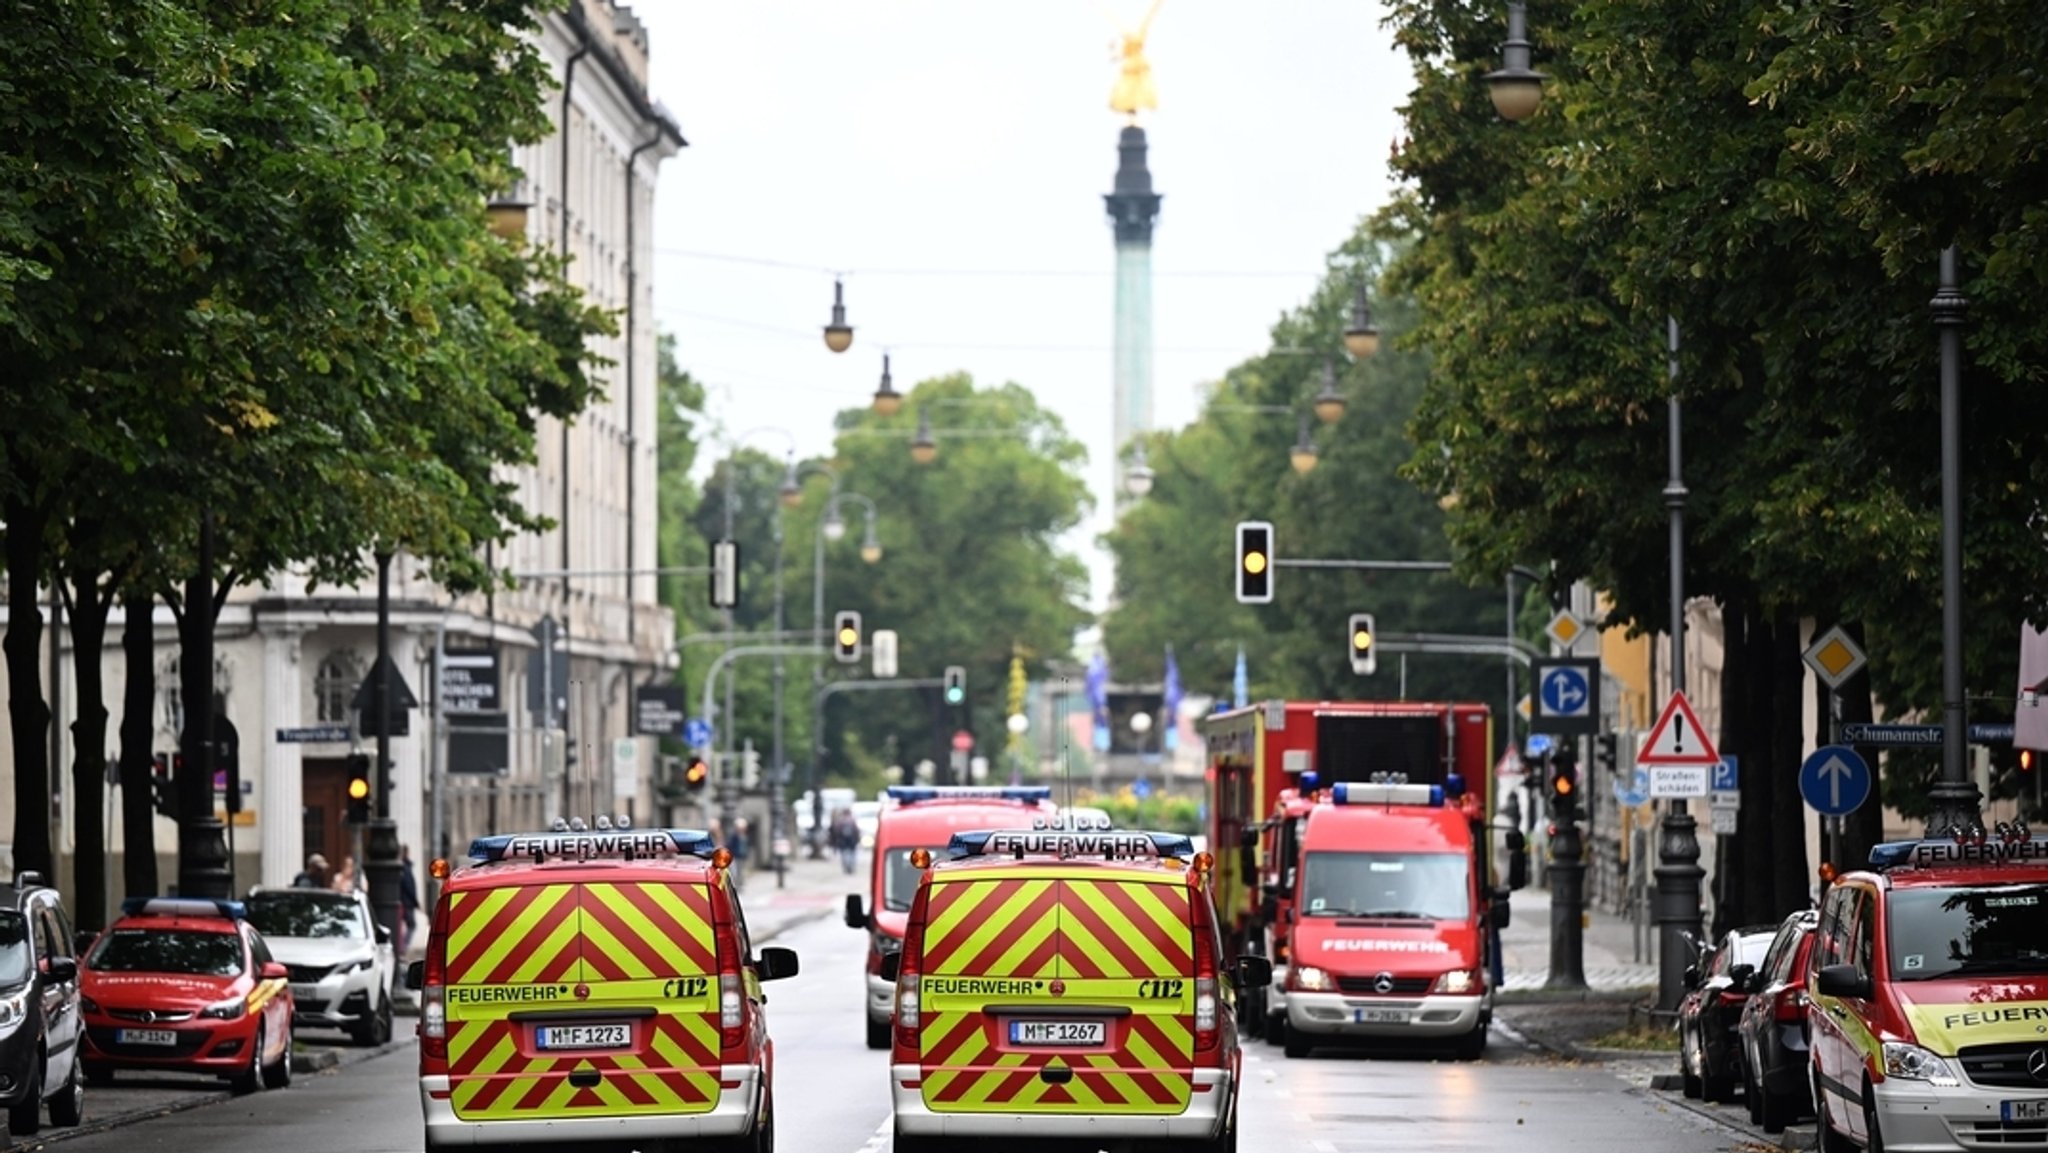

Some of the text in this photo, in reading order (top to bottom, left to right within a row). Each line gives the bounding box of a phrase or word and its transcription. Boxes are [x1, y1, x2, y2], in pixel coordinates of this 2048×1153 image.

[1844, 726, 1943, 743] Schumannstr.
[1656, 771, 1701, 780] Straßen-
[1657, 784, 1699, 793] schäden
[512, 834, 668, 857] FEUERWEHR
[993, 836, 1150, 855] FEUERWEHR
[1321, 938, 1450, 954] FEUERWEHR
[1907, 955, 1920, 967] 5
[96, 975, 217, 990] FEUERWEHR
[923, 979, 1184, 998] FEUERWEHR 112
[448, 979, 708, 1003] FEUERWEHR 112
